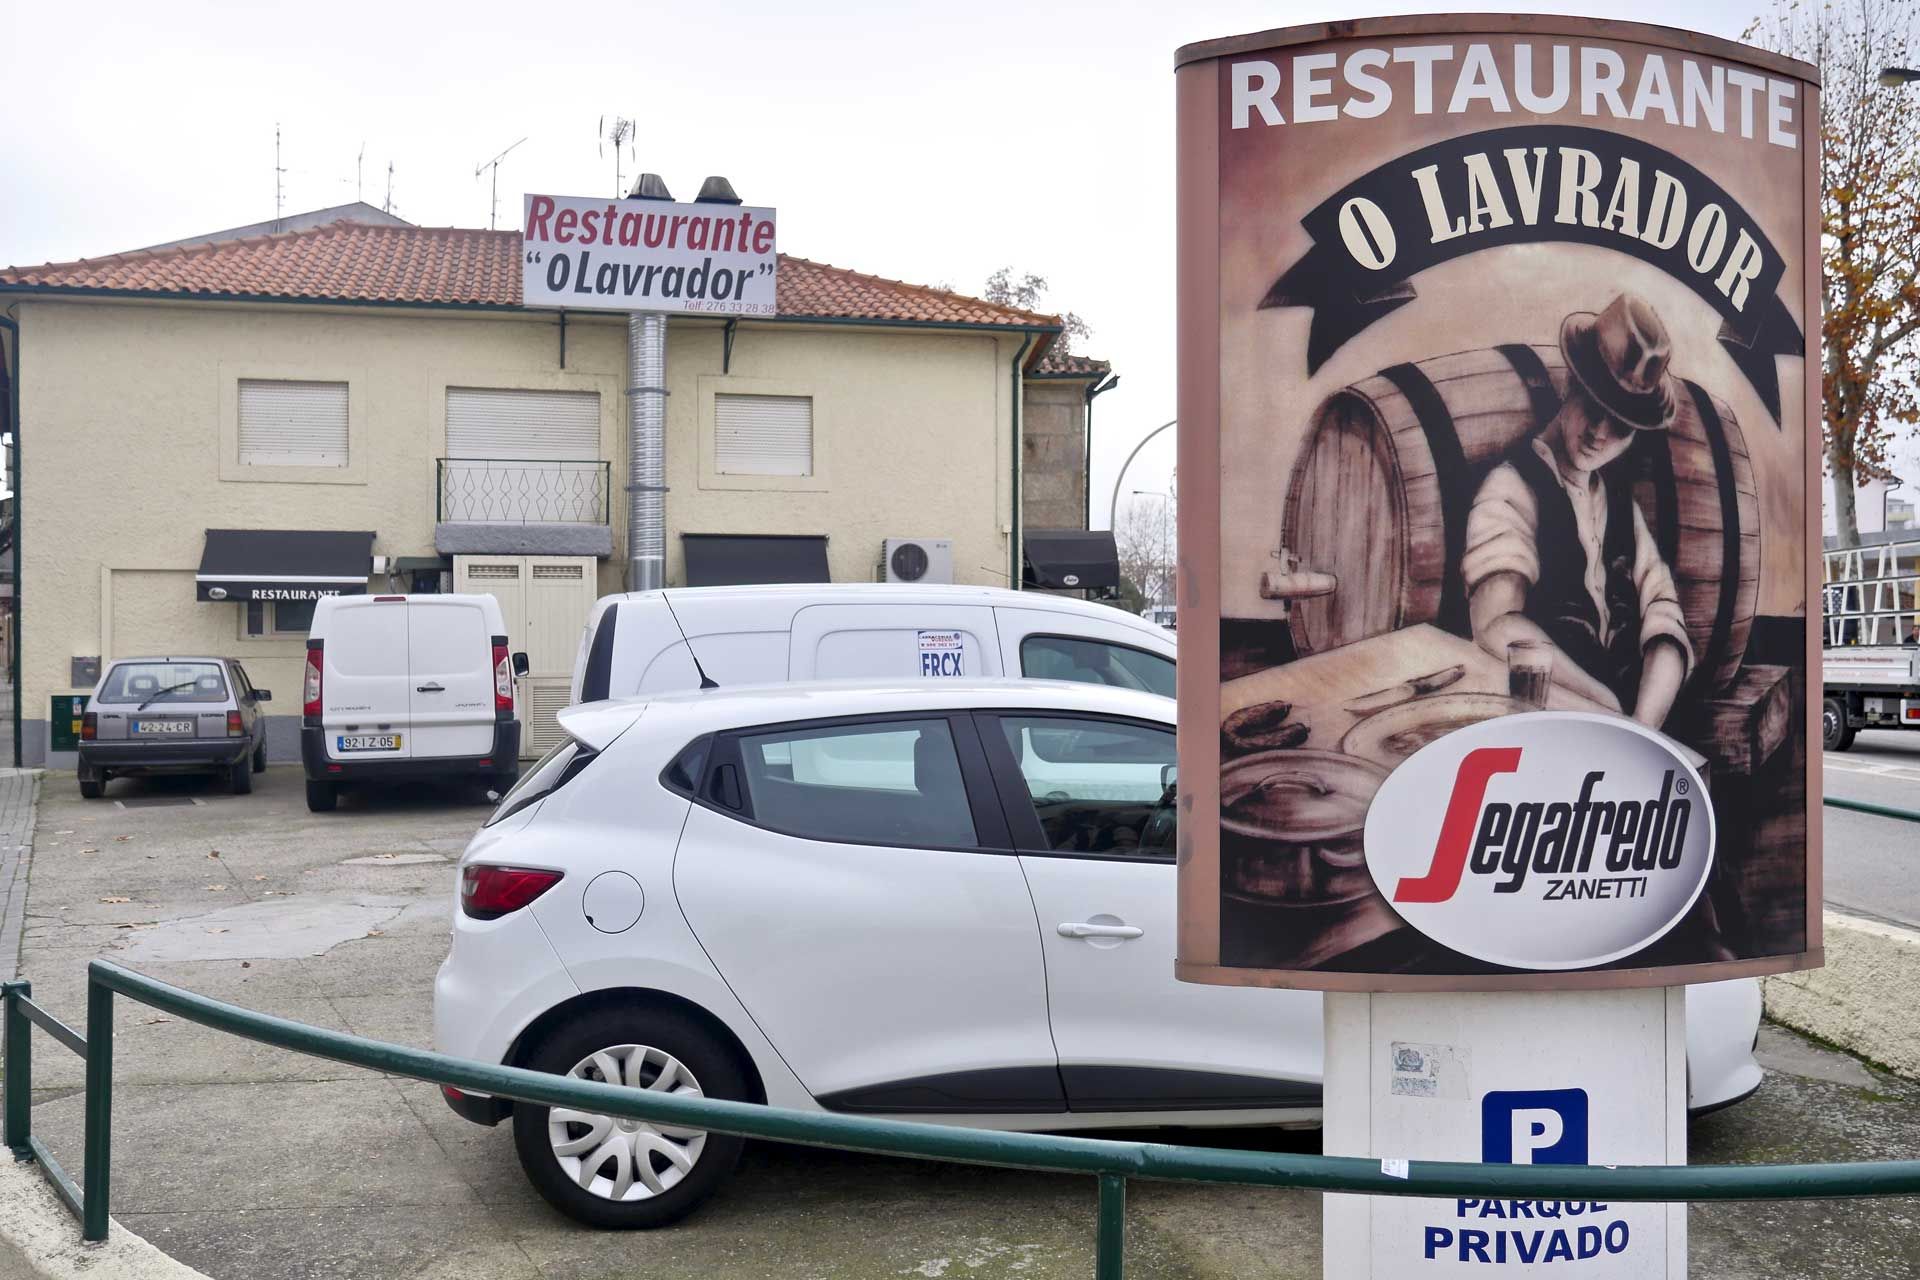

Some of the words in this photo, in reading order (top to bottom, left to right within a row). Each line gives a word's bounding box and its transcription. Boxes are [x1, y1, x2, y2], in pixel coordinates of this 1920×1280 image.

[1231, 43, 1798, 149] RESTAURANTE
[525, 195, 775, 254] Restaurante
[1338, 197, 1397, 271] O
[1411, 146, 1764, 313] LAVRADOR
[706, 302, 726, 312] 276
[729, 303, 742, 312] 33
[745, 303, 759, 313] 28
[761, 303, 775, 314] 38
[922, 652, 962, 677] FRCX
[1392, 746, 1691, 904] Segafredo
[1543, 877, 1648, 901] ZANETTI
[1424, 1220, 1630, 1264] PRIVADO
